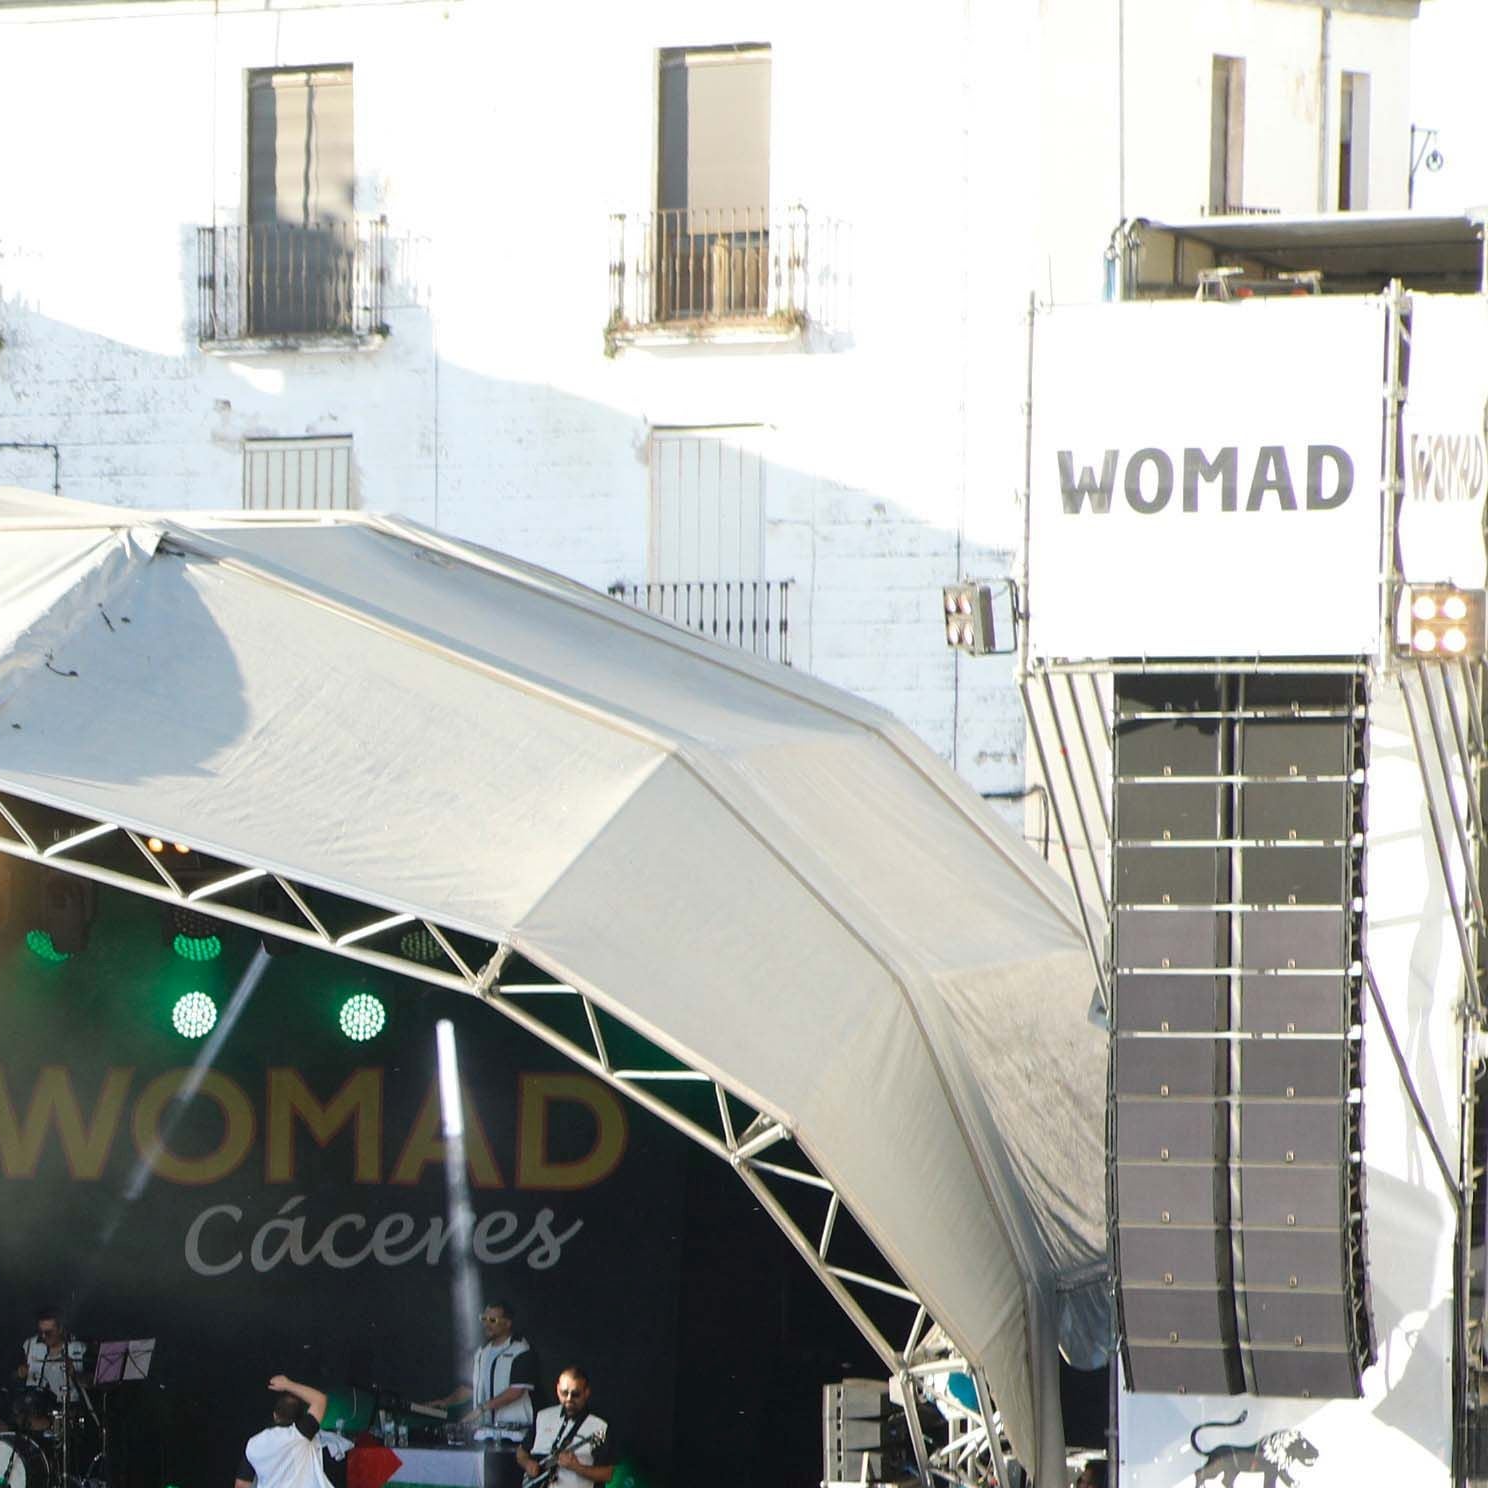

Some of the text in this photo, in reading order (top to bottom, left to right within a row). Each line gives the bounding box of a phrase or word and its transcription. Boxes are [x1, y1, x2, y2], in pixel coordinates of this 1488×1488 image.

[1057, 445, 1354, 514] WOMAD
[1411, 433, 1483, 502] WOMAD
[184, 1196, 583, 1277] Cáceres
